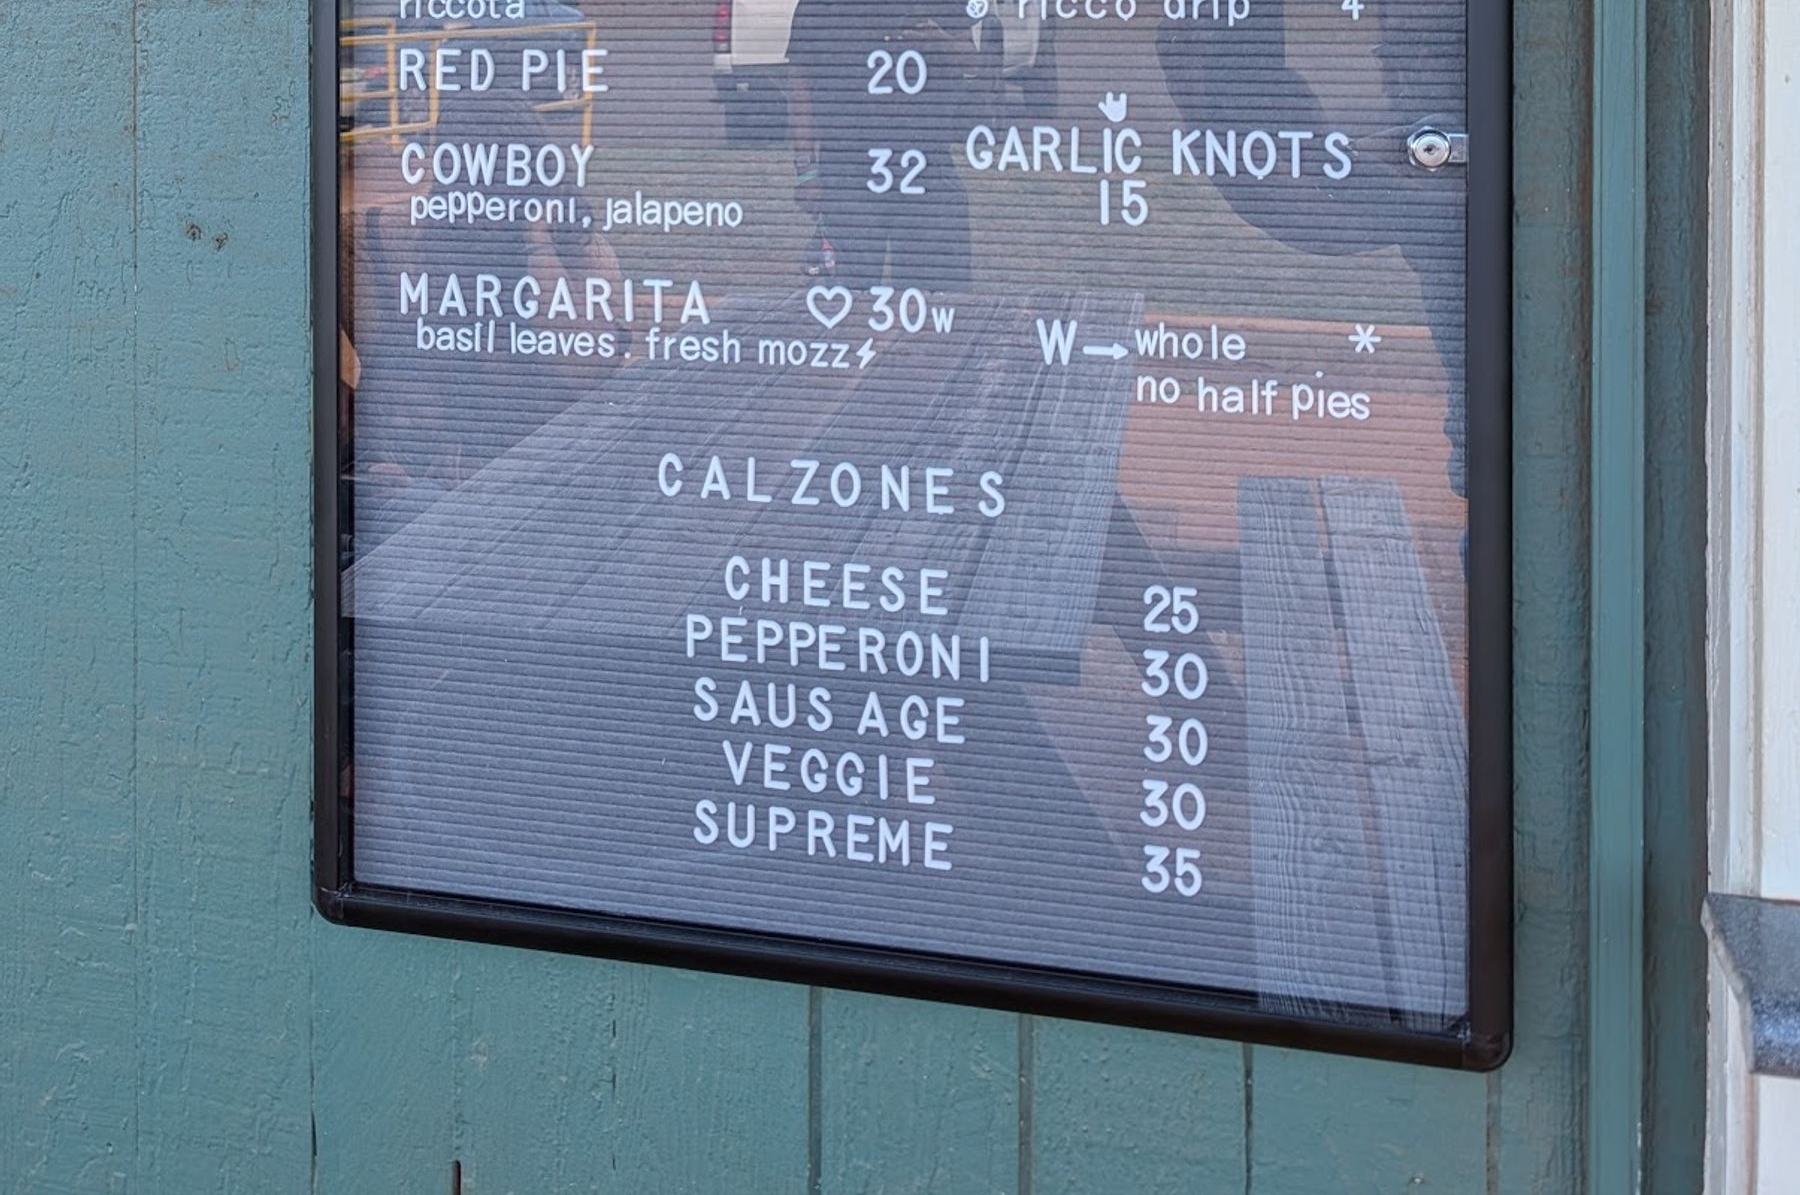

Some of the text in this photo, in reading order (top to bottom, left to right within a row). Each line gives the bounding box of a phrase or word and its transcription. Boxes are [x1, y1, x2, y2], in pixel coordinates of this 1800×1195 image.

[400, 48, 609, 92] RED PIE
[867, 50, 927, 94] 20
[400, 143, 594, 189] COWBOY
[867, 149, 926, 195] 32
[967, 126, 1351, 180] GARLIC KNOTS
[411, 191, 742, 232] pepperoni, jalapeno
[1100, 180, 1148, 226] 15
[400, 271, 710, 325] MARGARITA
[417, 318, 495, 354] basil
[646, 328, 741, 364] fresh
[758, 340, 849, 369] mozz
[1036, 319, 1246, 366] W whole
[1138, 371, 1370, 420] no half pies
[658, 453, 1005, 518] CALZONES
[725, 555, 949, 616] CHEESE
[1143, 585, 1199, 634] 25
[686, 614, 989, 683] PEPPERONI
[1141, 650, 1207, 700] 30
[1143, 715, 1208, 766] 30
[722, 740, 935, 804] VEGGIE
[1140, 780, 1206, 831] 30
[694, 801, 954, 871] SUPREME
[1141, 845, 1202, 897] 35
